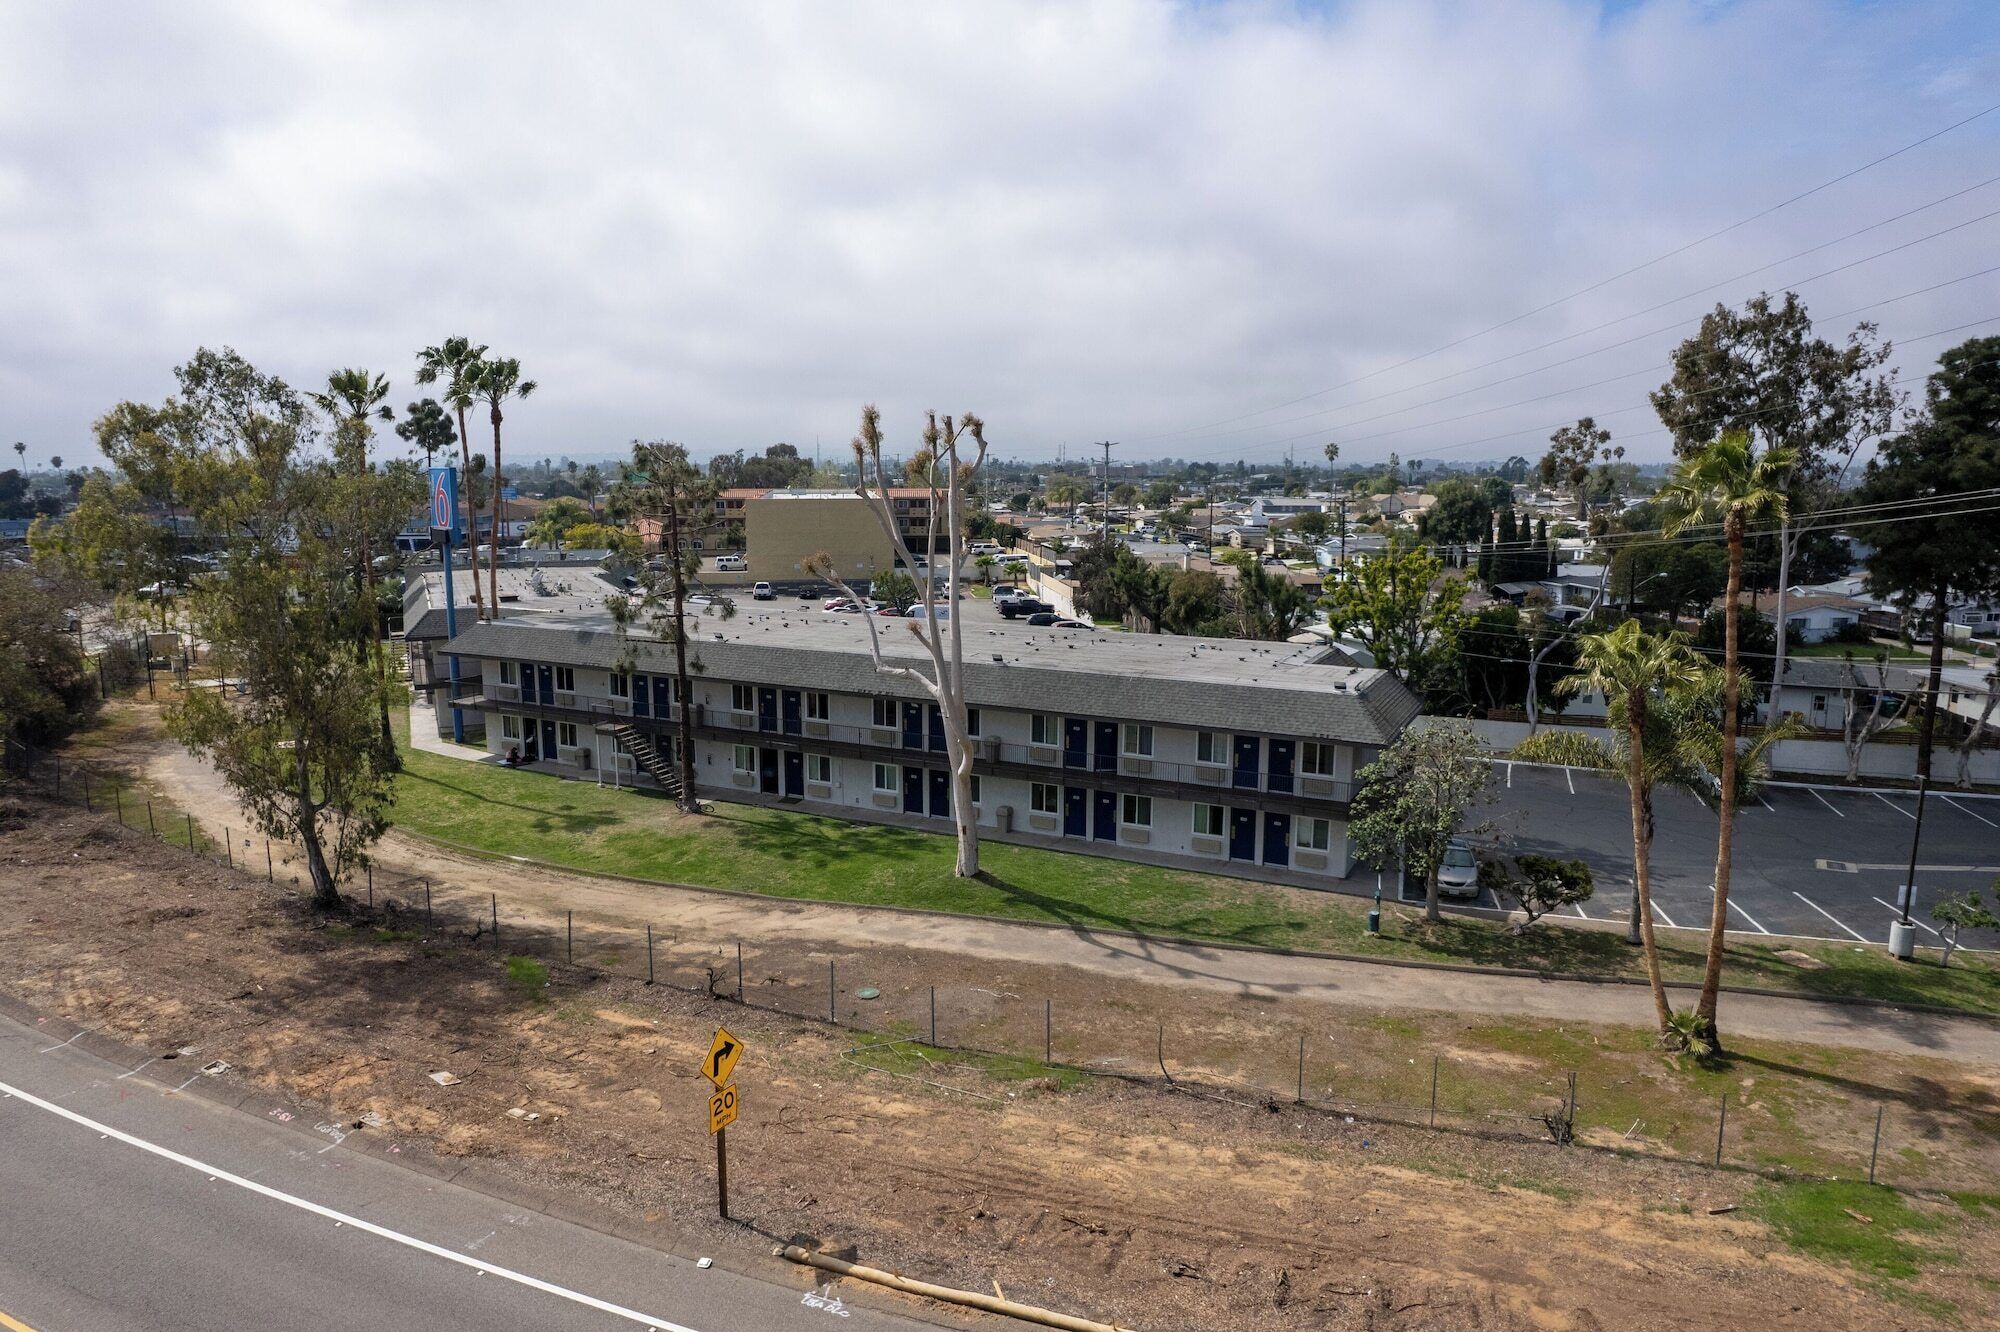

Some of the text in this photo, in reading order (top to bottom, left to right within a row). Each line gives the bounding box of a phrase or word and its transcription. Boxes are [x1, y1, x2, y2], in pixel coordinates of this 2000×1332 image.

[435, 472, 450, 528] 6
[713, 1091, 734, 1117] 20
[716, 1112, 732, 1126] MPH
